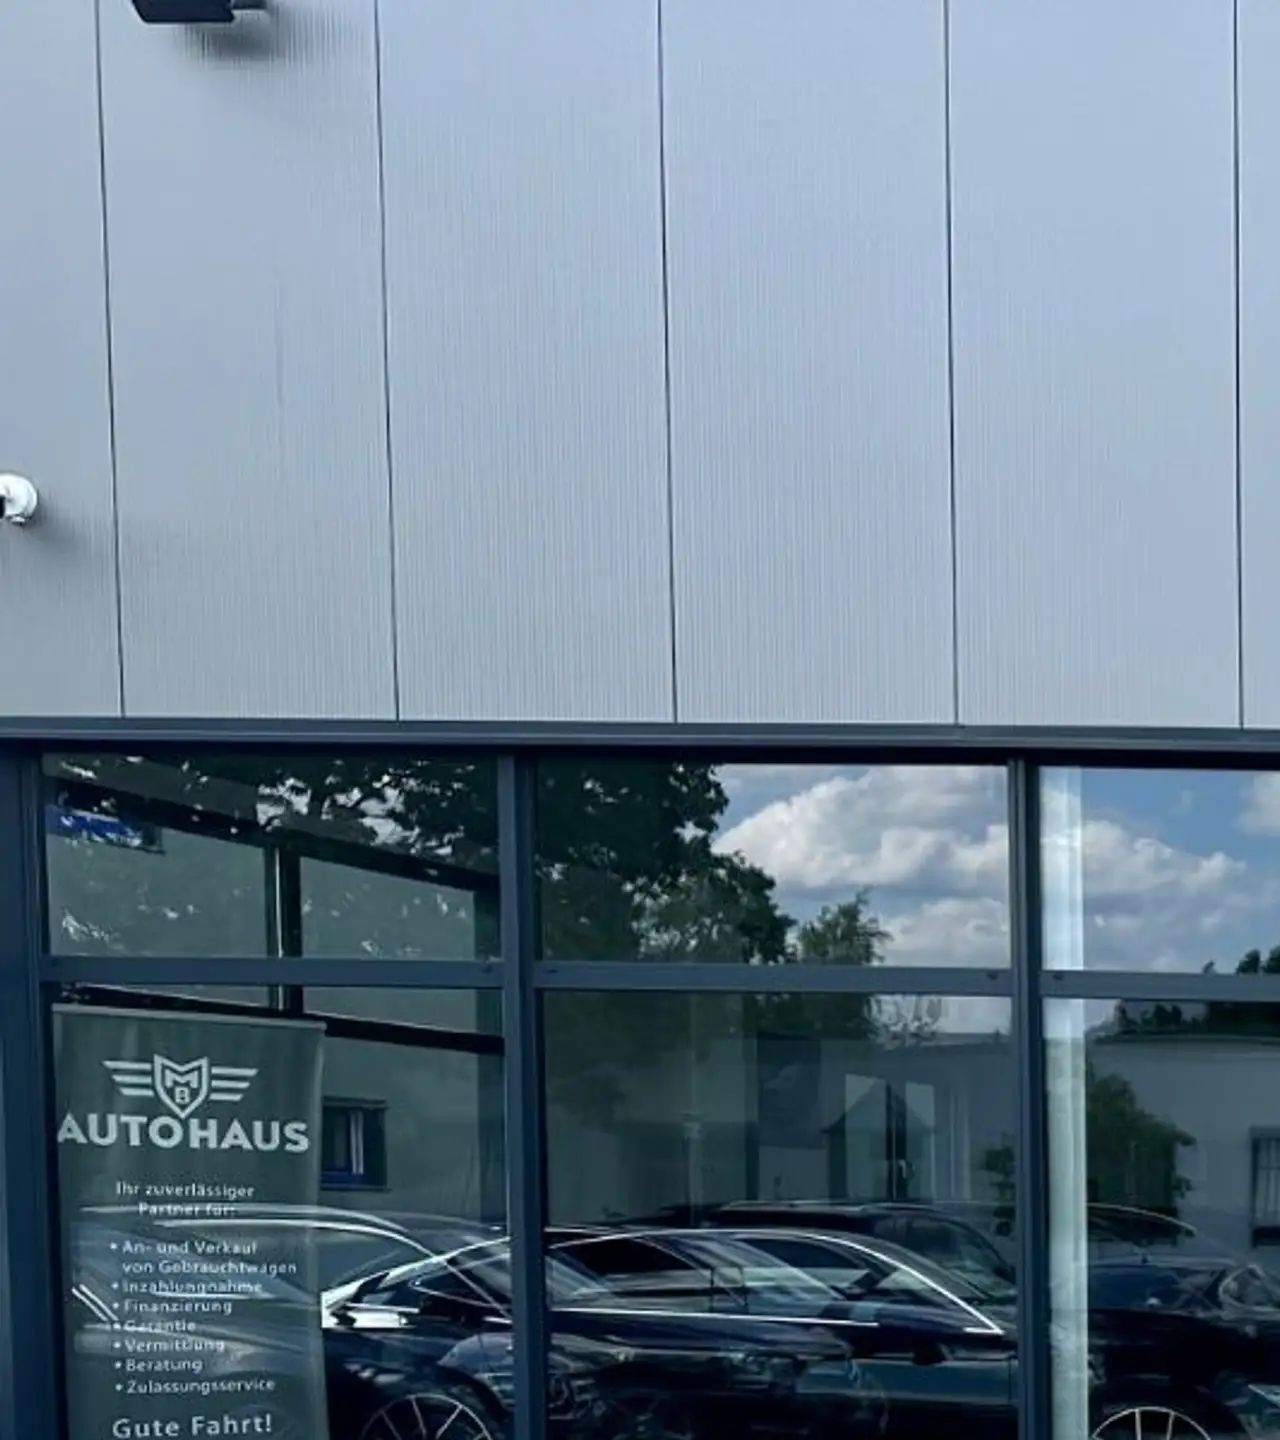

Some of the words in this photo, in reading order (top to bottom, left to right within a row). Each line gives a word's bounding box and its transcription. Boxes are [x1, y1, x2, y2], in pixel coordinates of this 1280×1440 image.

[57, 1111, 310, 1153] AUTOHAUS
[116, 1181, 141, 1196] Ihr
[145, 1182, 256, 1200] zuverlässiger
[138, 1202, 200, 1217] Partner
[156, 1240, 189, 1254] und
[194, 1240, 258, 1255] Verkauf
[122, 1261, 154, 1275] von
[158, 1259, 298, 1279] Gebrauchtwagen
[123, 1279, 265, 1296] Inzahlungnahme
[124, 1299, 233, 1315] Finanzierung
[124, 1339, 226, 1354] Vermittlung
[126, 1359, 205, 1375] Beratung
[126, 1378, 277, 1396] Zulassungsservice
[112, 1417, 181, 1440] Gute
[191, 1413, 273, 1437] Fahrt!
